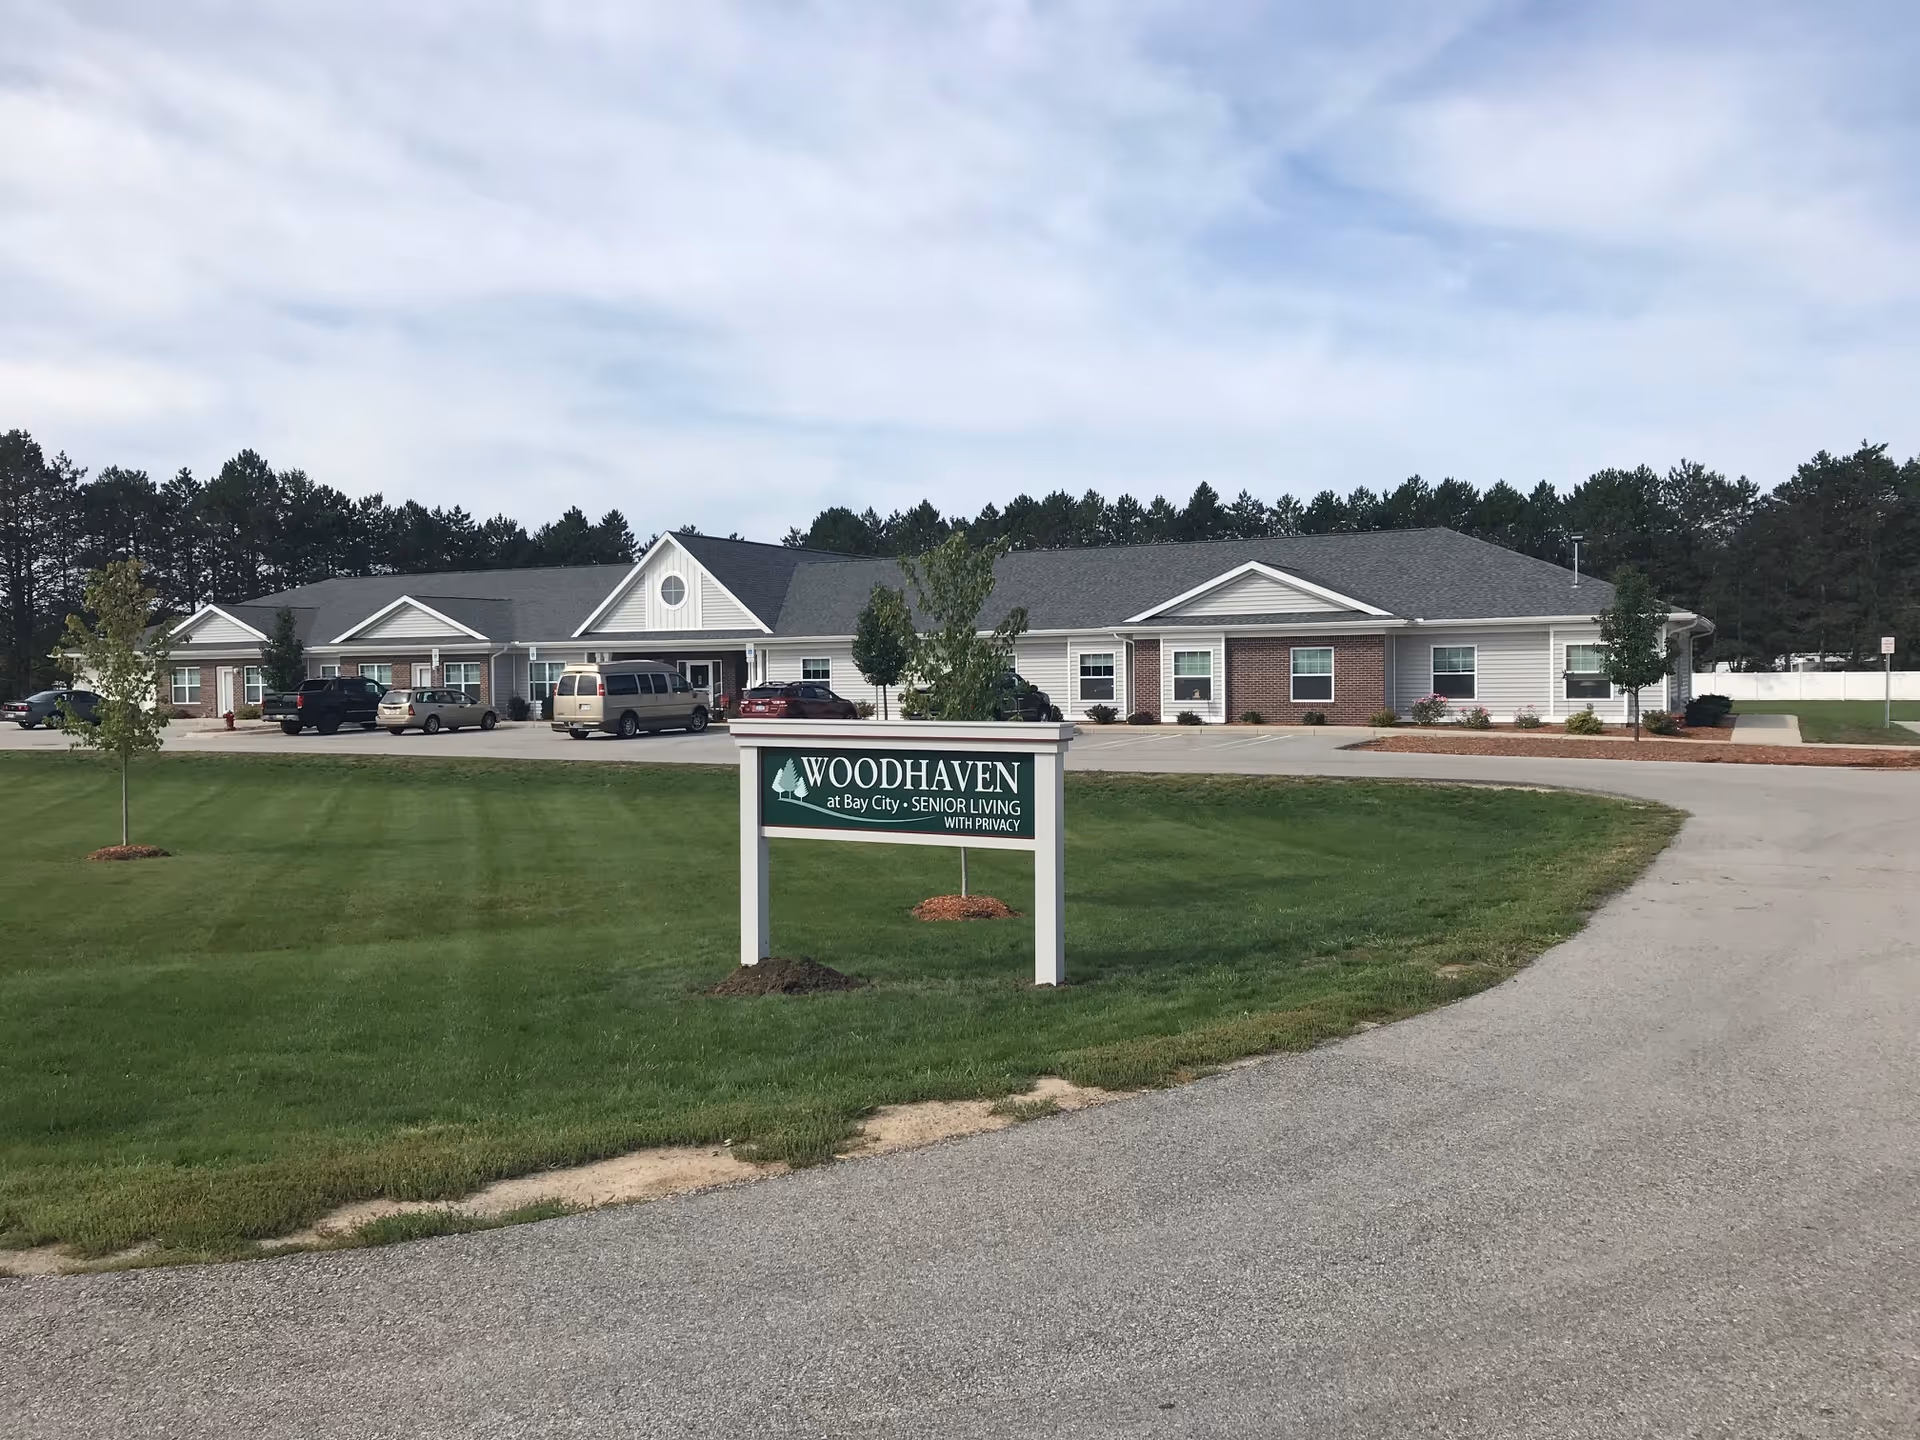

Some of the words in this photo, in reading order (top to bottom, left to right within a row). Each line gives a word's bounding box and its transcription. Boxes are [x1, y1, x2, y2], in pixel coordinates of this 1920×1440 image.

[801, 756, 1020, 794] WOODHAVEN
[827, 794, 840, 808] at
[844, 793, 869, 813] Bay
[872, 794, 900, 814] City
[911, 796, 966, 813] SENIOR
[970, 799, 1021, 815] LIVING
[944, 816, 972, 829] WITH
[976, 818, 1021, 831] PRIVACY
